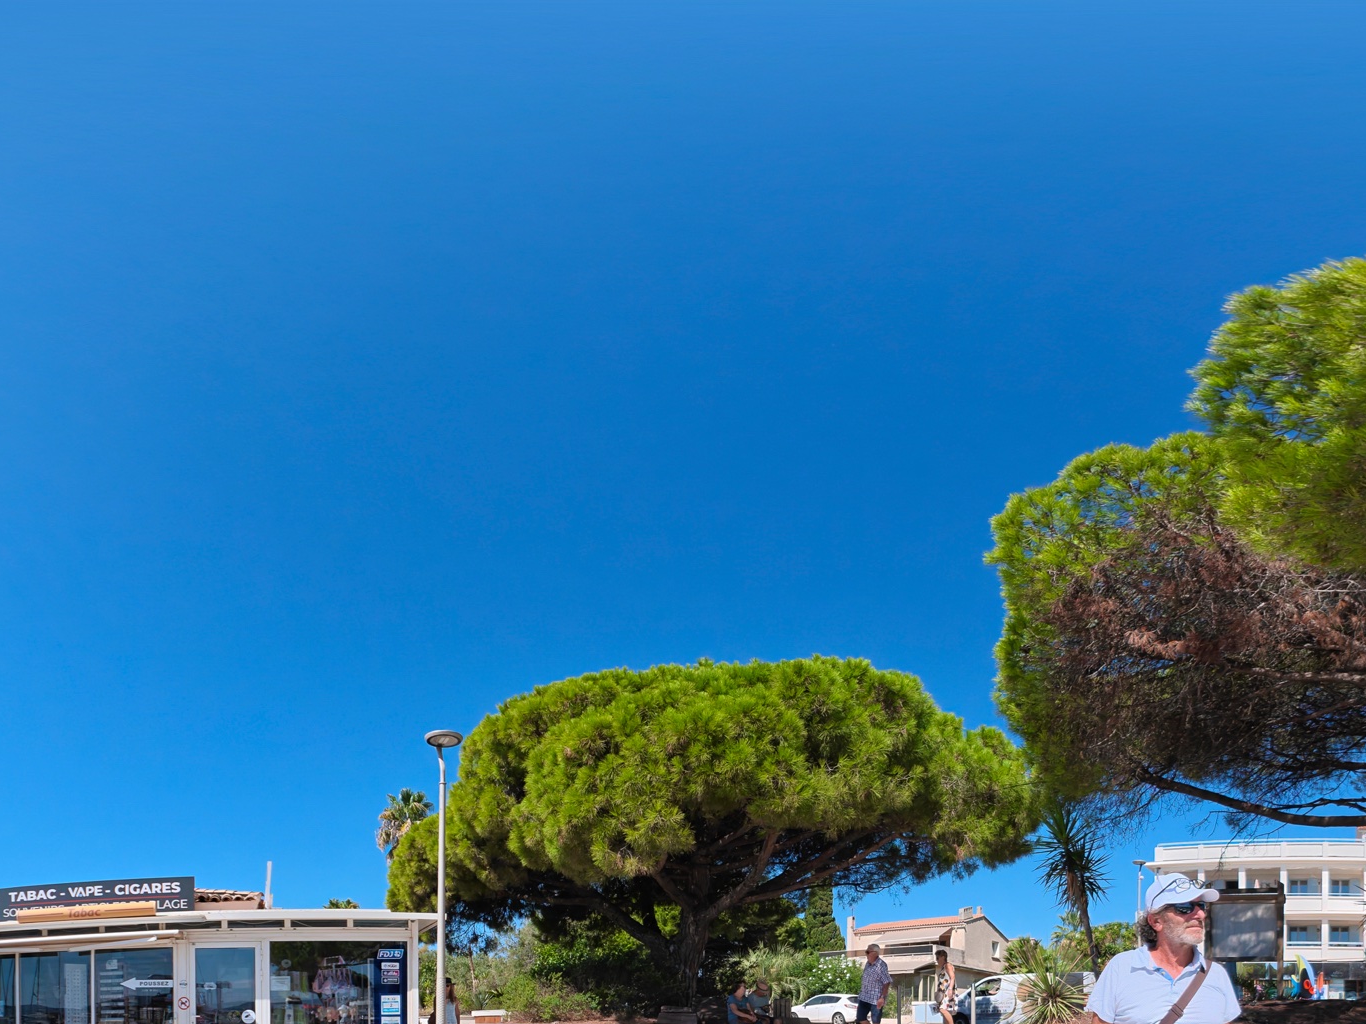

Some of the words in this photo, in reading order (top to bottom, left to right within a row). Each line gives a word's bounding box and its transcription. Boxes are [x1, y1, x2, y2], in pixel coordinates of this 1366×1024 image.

[8, 889, 56, 902] TABAC
[68, 886, 104, 898] VAPE
[114, 882, 180, 895] CIGARES
[150, 899, 188, 910] LAGE
[68, 908, 101, 918] Tabac
